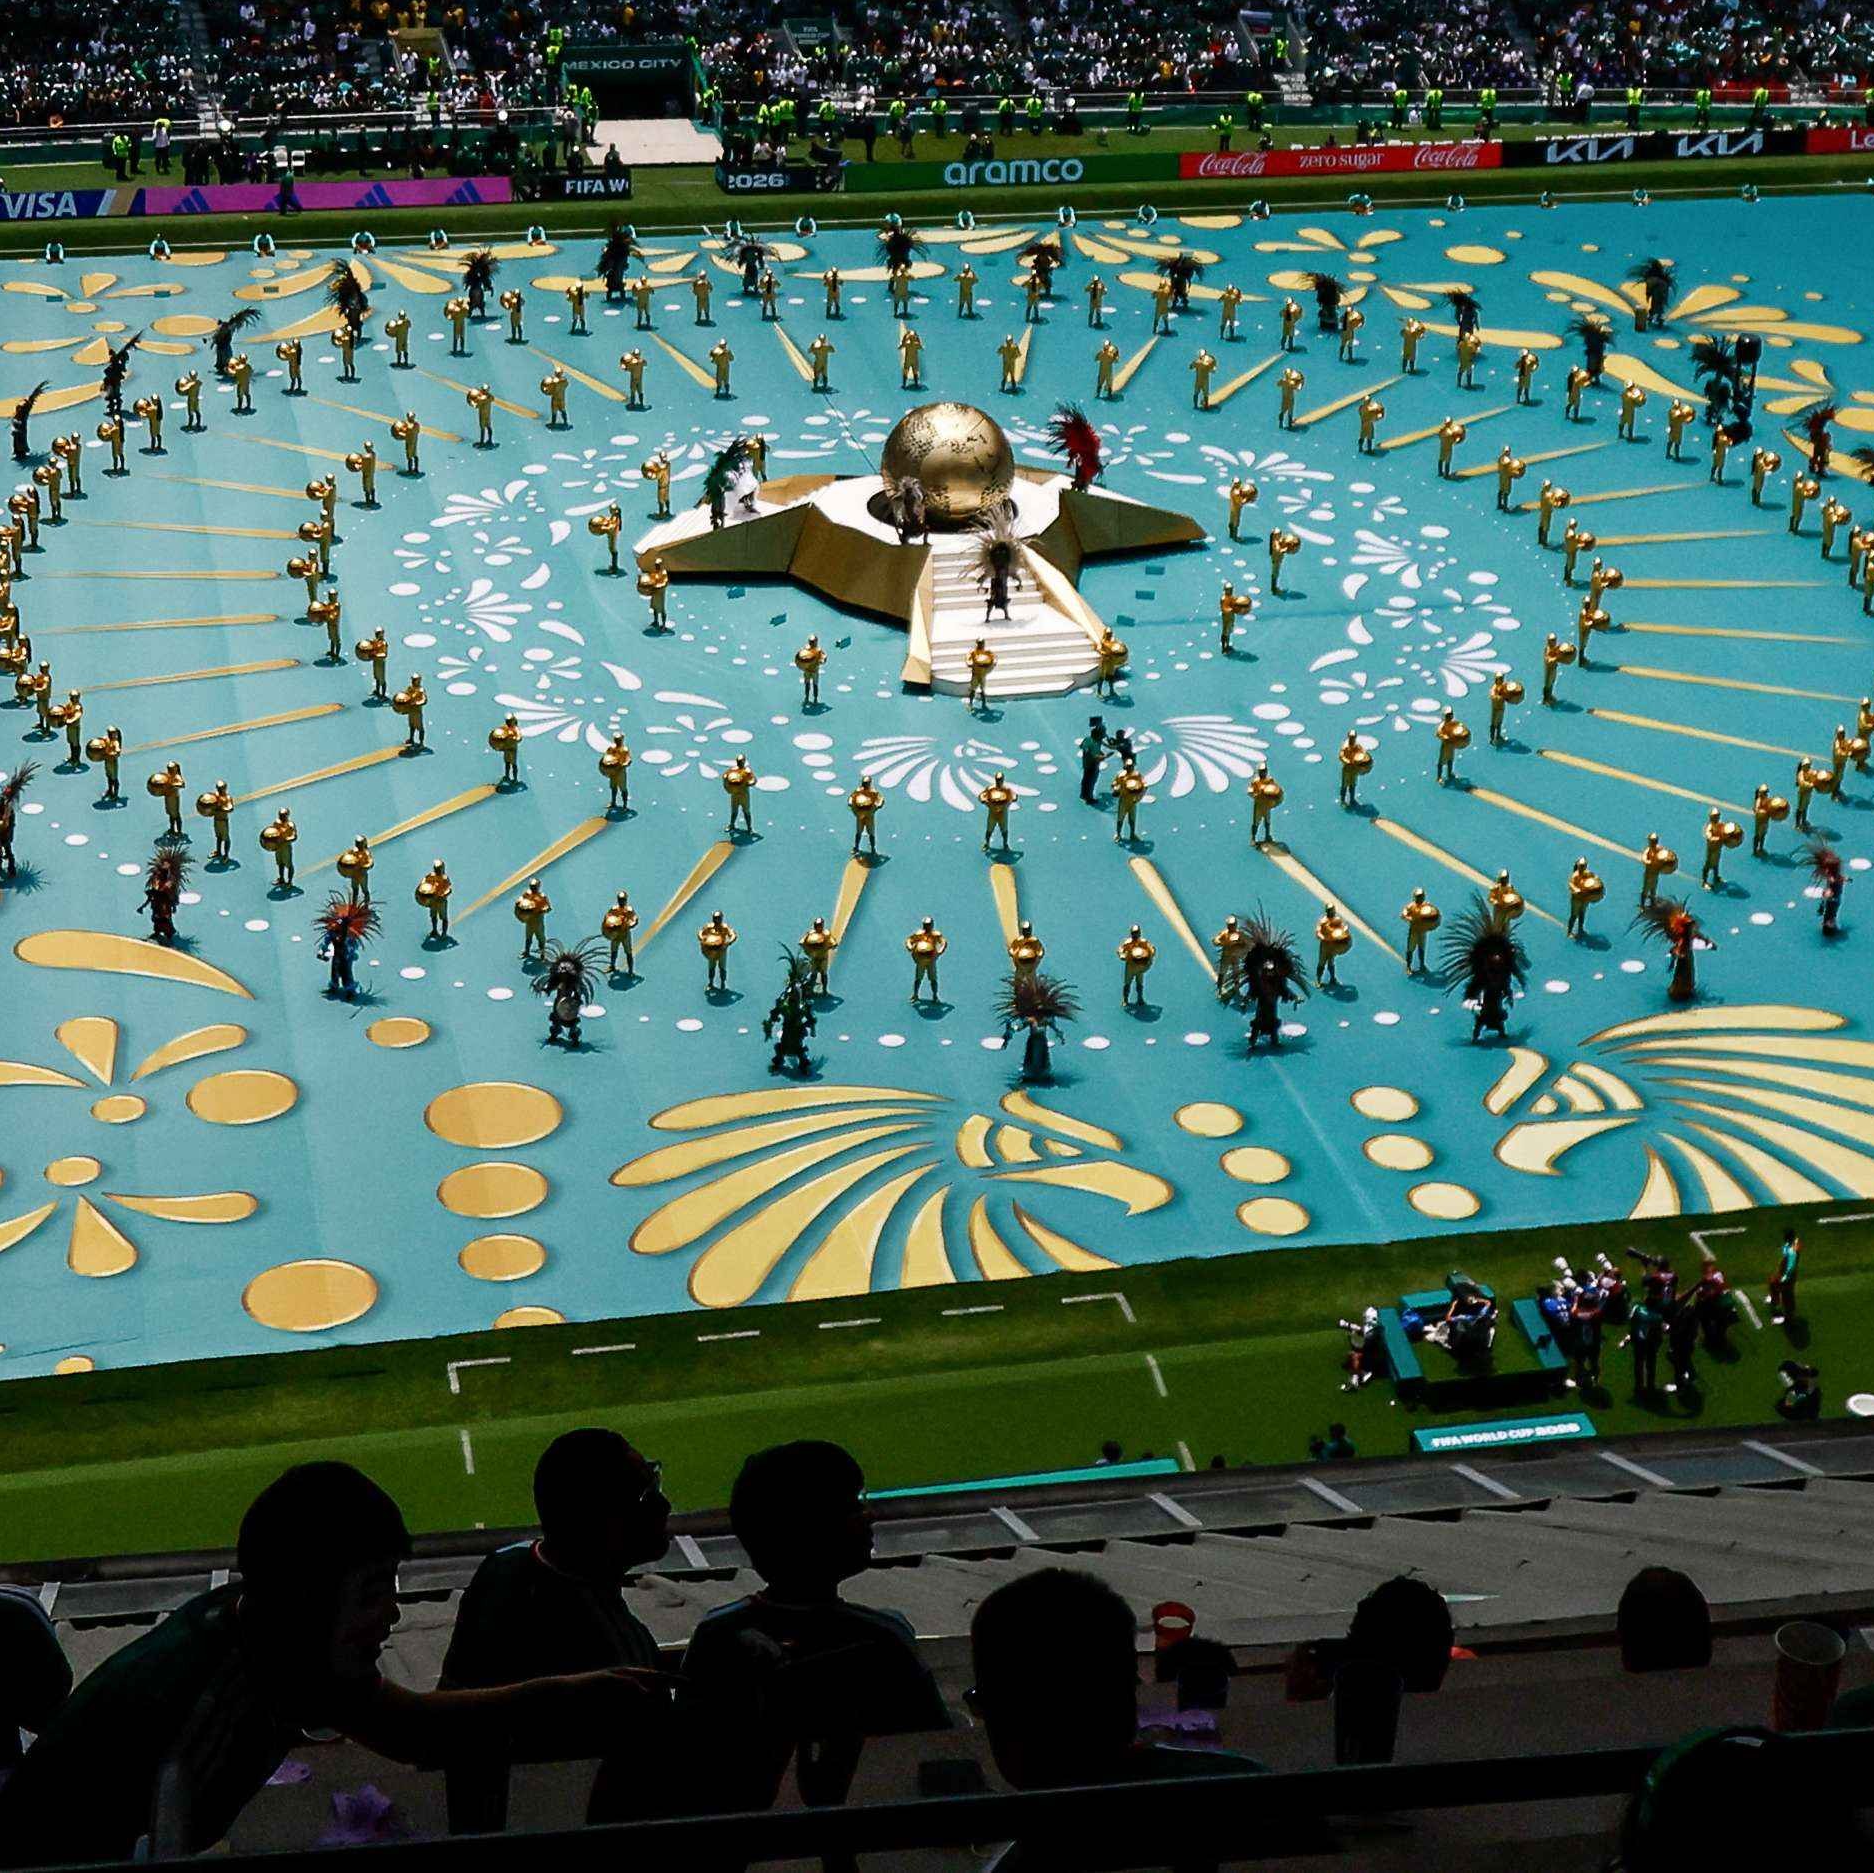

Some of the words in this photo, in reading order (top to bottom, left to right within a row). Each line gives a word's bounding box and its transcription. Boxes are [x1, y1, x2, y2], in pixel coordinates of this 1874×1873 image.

[563, 58, 635, 72] MEXICO
[638, 58, 685, 72] CITY
[1544, 135, 1636, 165] KIA
[1676, 131, 1765, 160] KIA
[943, 159, 1084, 187] aramco
[1298, 148, 1338, 170] zero
[1339, 148, 1386, 173] sugar
[565, 178, 605, 195] FIFA
[1, 191, 78, 221] VISA
[1431, 1435, 1463, 1448] FIFA
[1462, 1430, 1508, 1445] WORLD
[1508, 1427, 1535, 1440] CUP
